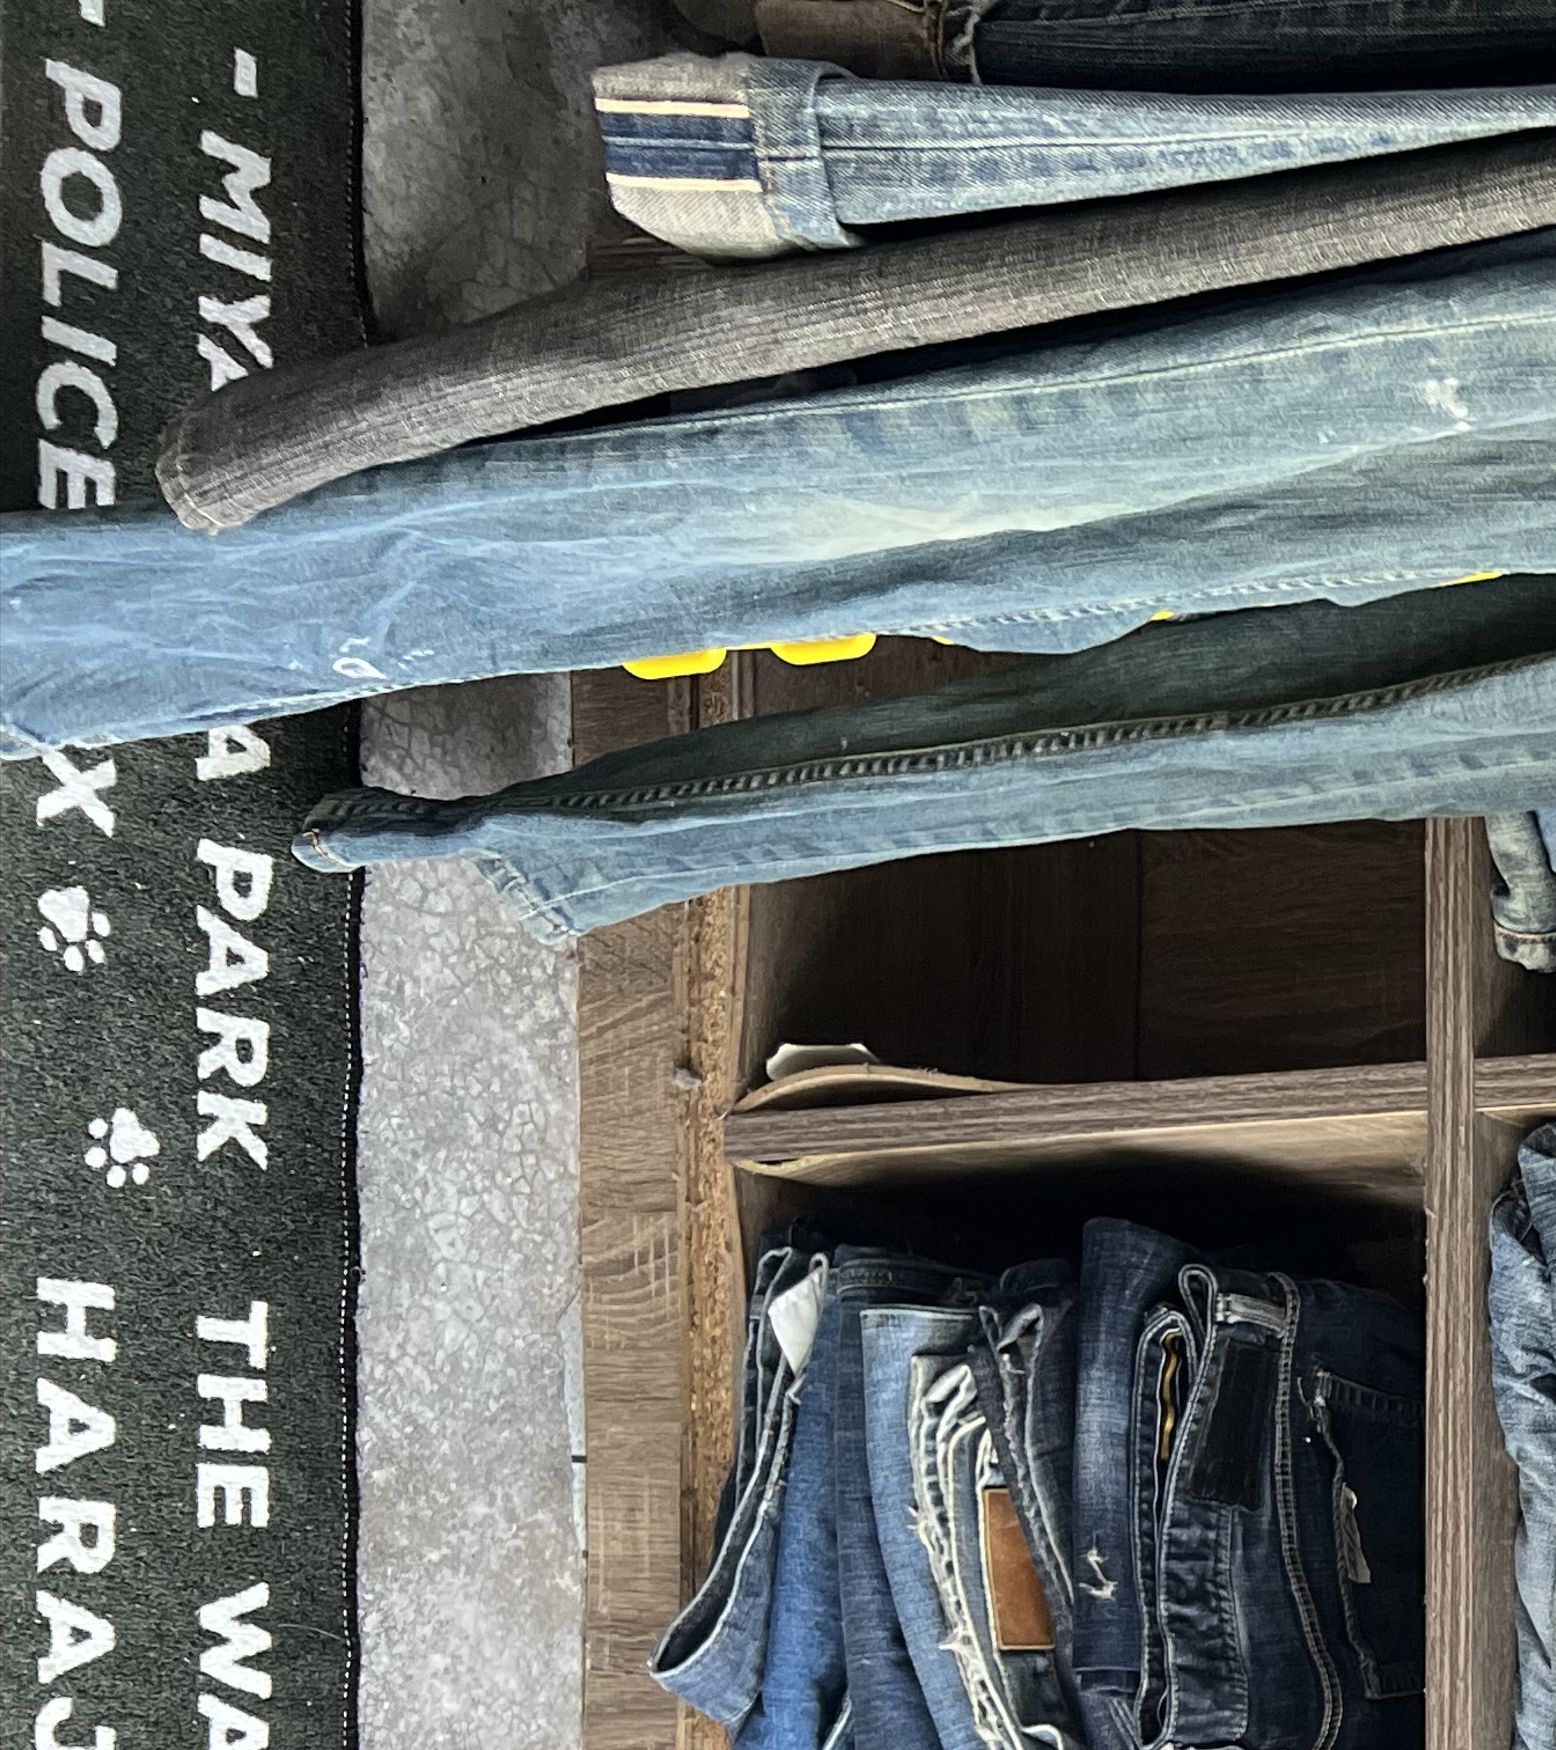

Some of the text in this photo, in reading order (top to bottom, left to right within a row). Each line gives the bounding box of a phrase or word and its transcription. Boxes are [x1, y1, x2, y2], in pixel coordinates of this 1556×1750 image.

[35, 58, 123, 510] POLICE
[195, 838, 273, 1170] PARK
[195, 1300, 272, 1528] THE
